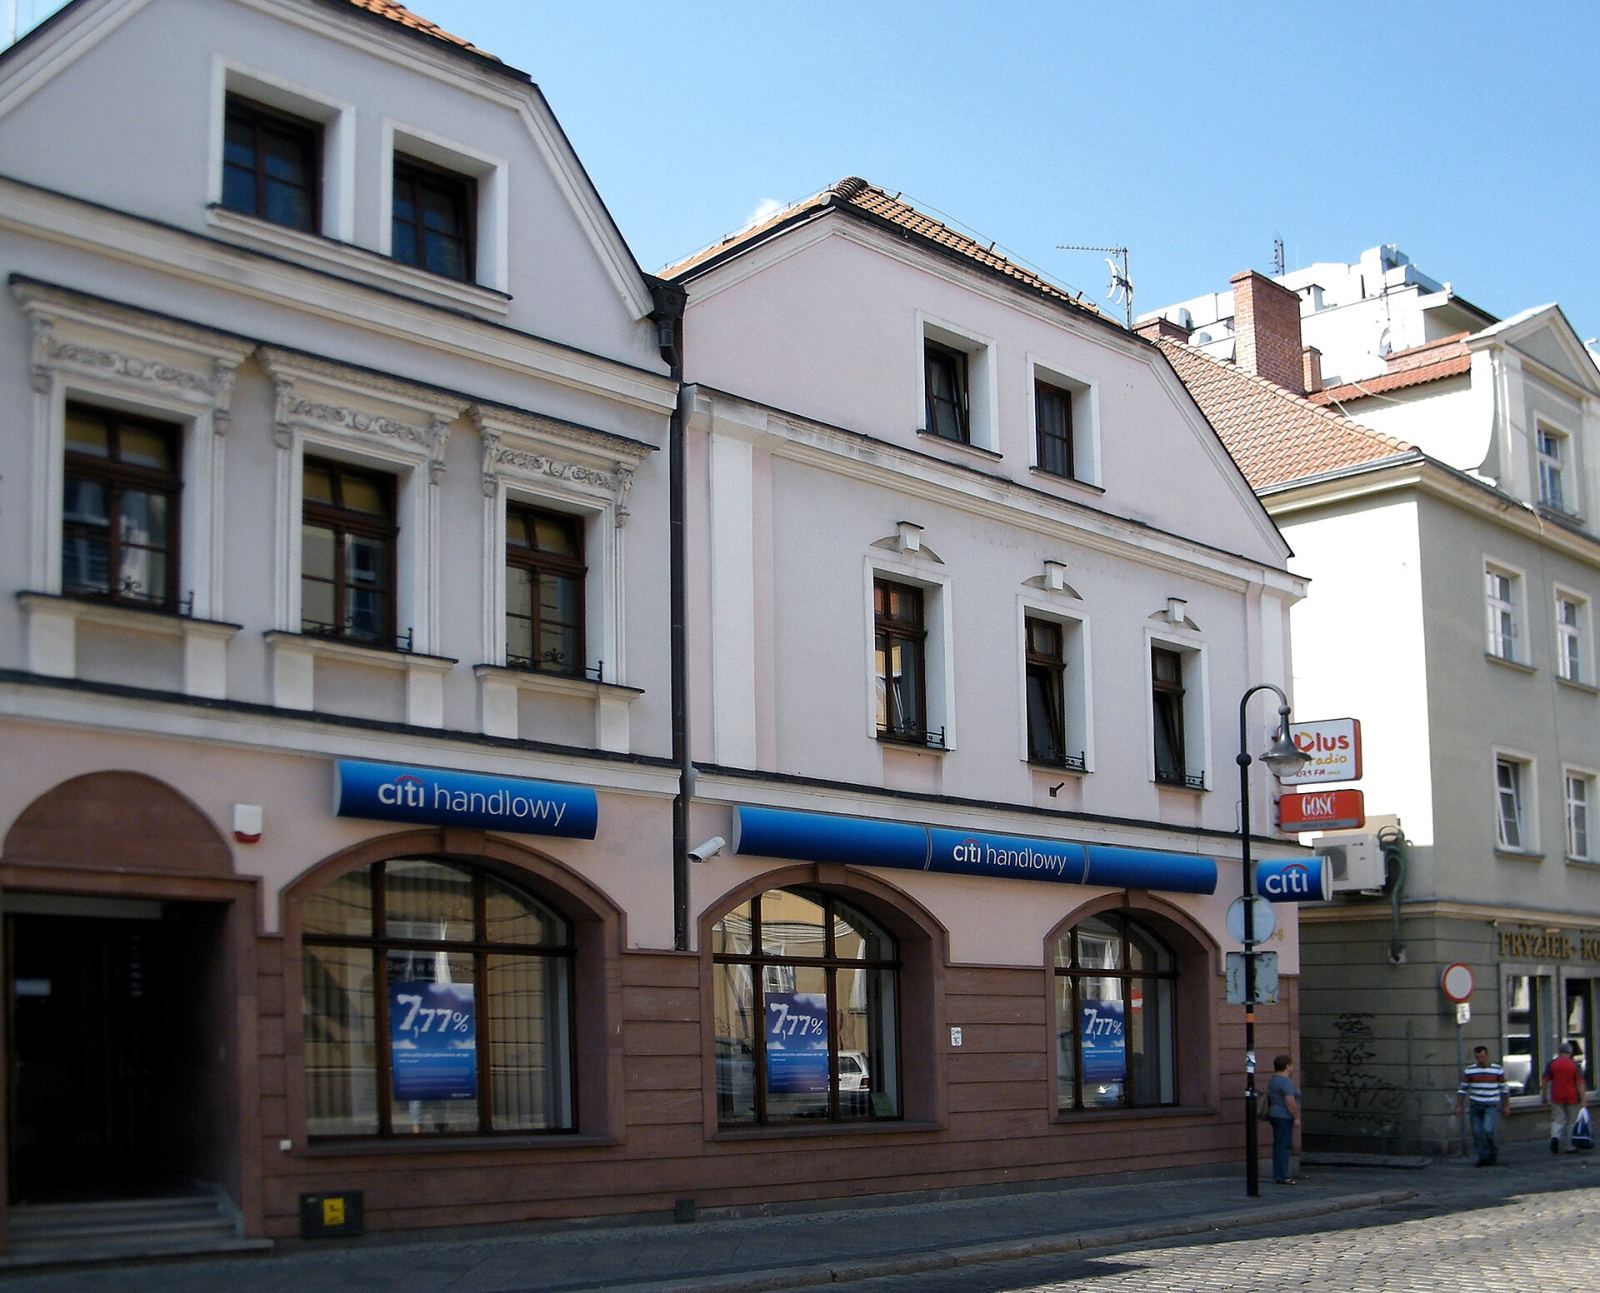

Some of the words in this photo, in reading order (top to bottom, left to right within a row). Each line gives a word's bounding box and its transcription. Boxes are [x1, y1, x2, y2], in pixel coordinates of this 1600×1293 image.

[378, 776, 424, 808] citi
[434, 782, 567, 828] handlowy
[953, 840, 981, 864] citi
[986, 843, 1067, 876] handlowy
[1265, 865, 1309, 894] citi
[1500, 930, 1570, 959] FRYZJER
[397, 994, 470, 1039] 7,77%
[769, 1003, 824, 1041] 7,77%
[1084, 1008, 1123, 1040] 7,77%
